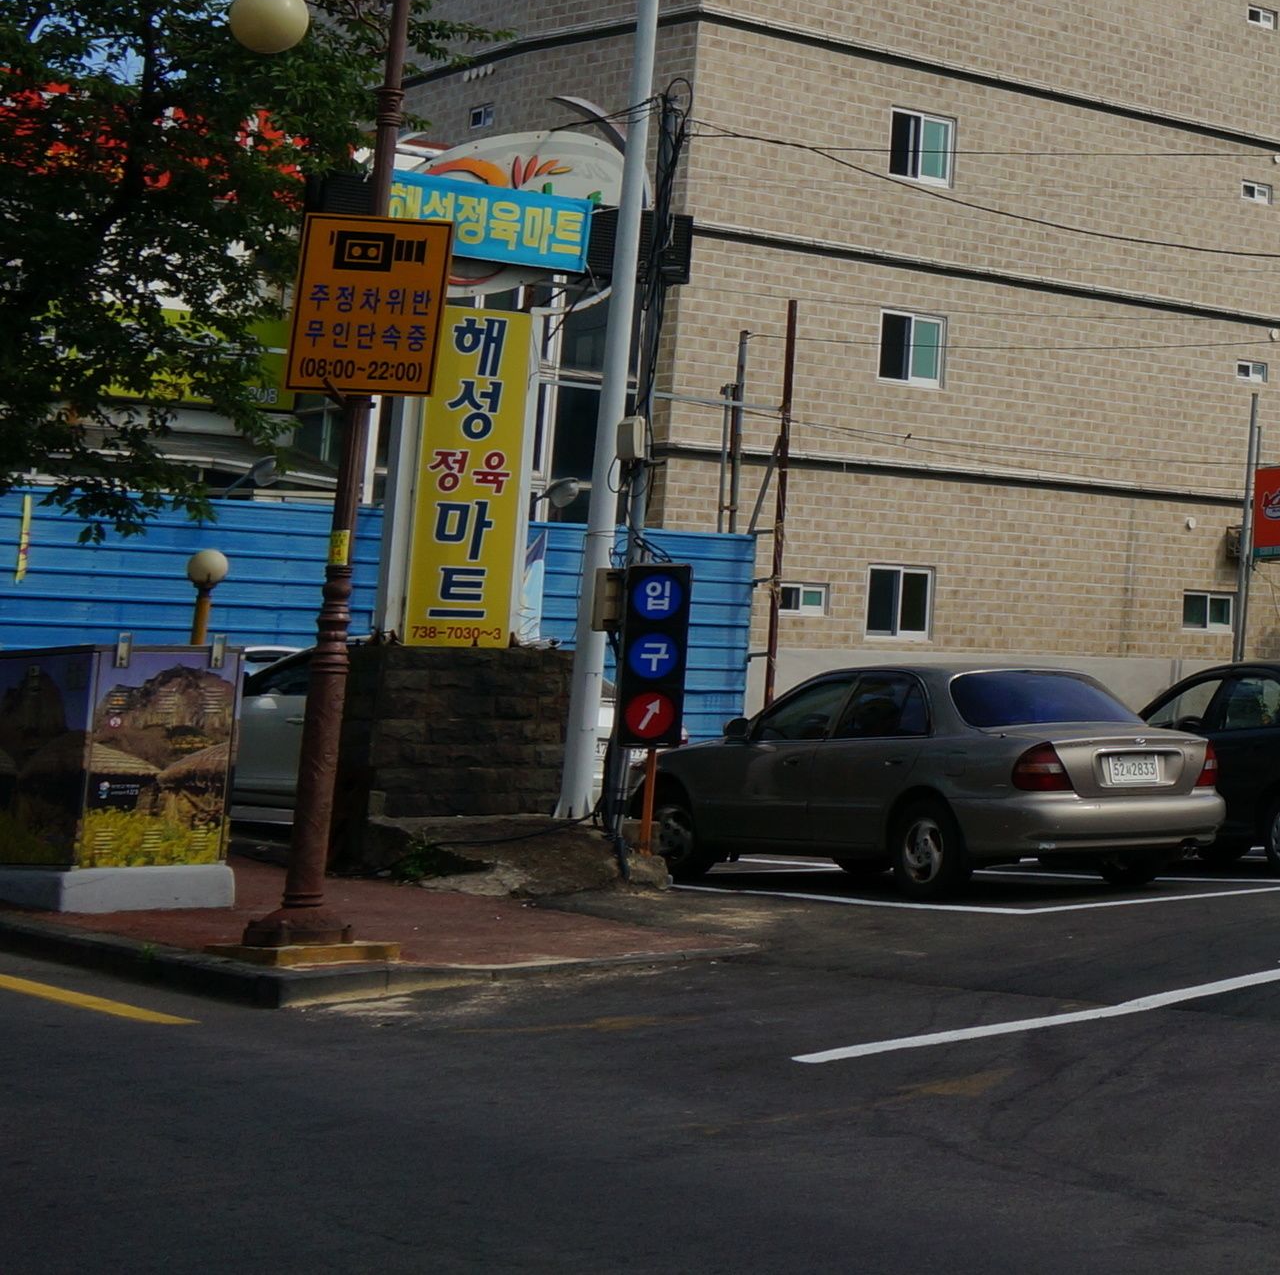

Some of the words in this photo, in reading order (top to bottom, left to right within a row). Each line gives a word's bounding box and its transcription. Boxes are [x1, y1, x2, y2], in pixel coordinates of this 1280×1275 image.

[308, 283, 432, 316] 주정차위반
[304, 320, 427, 352] 무인단속중
[299, 357, 423, 383] (08:00~22:00)
[411, 625, 502, 640] 738-7030~3
